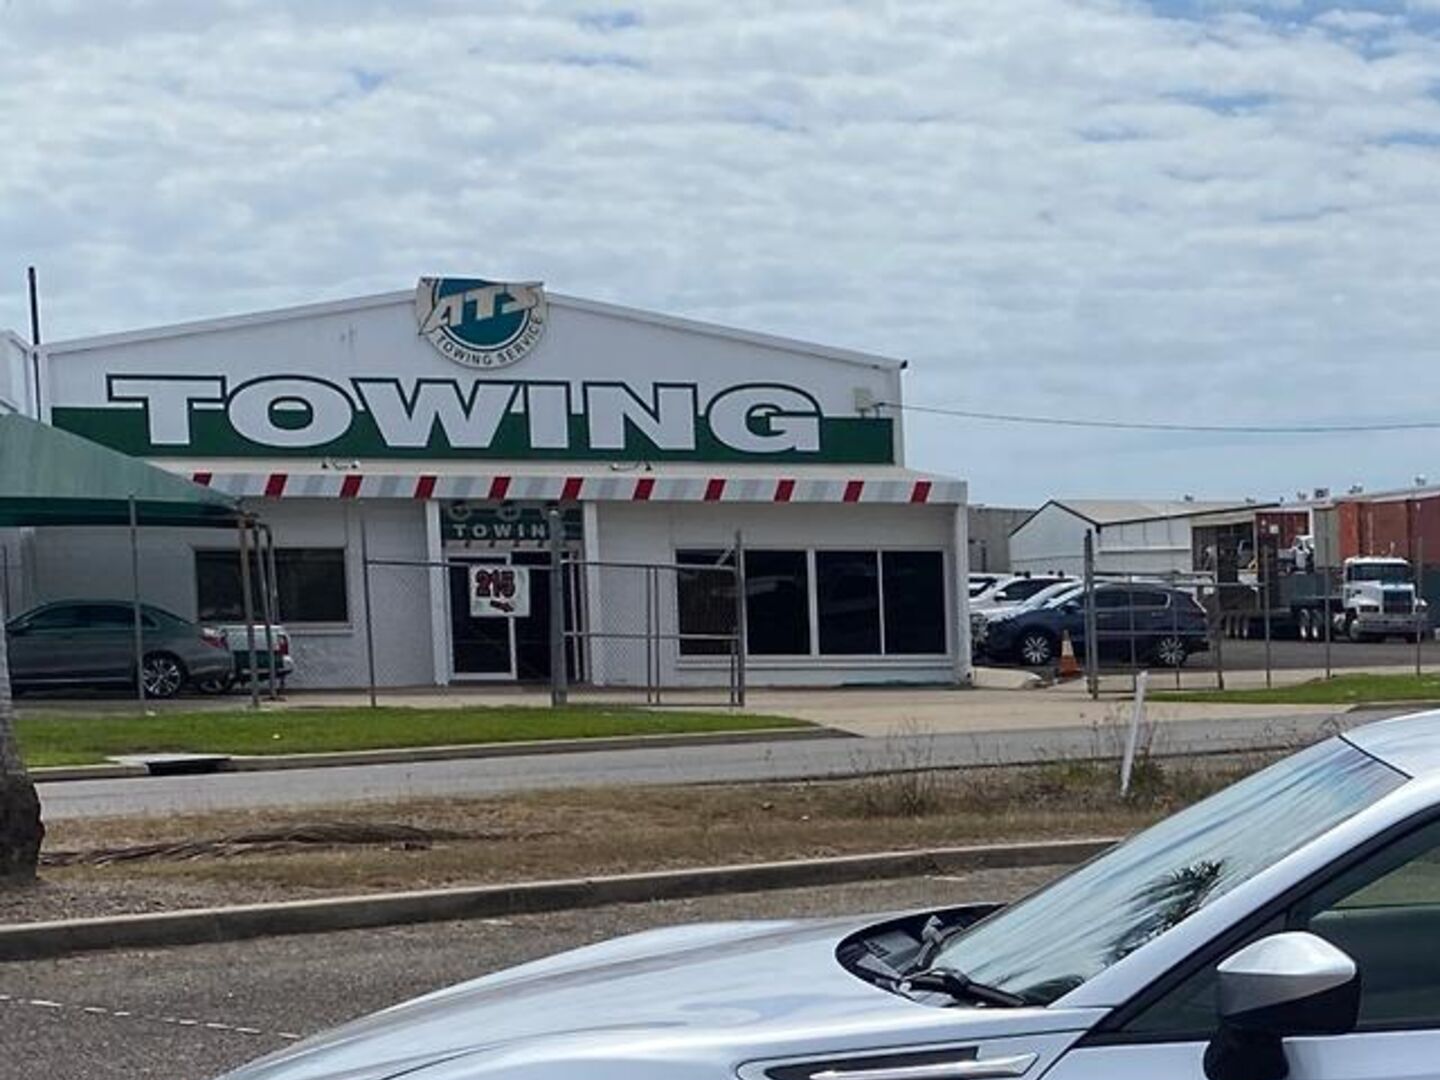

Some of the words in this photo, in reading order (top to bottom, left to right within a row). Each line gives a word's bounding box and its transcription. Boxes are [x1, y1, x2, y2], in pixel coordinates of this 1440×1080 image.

[420, 285, 538, 334] ATS
[435, 333, 492, 365] TOWING
[497, 315, 542, 363] SERVICE
[106, 375, 822, 453] TOWING
[452, 523, 566, 539] TOWIN
